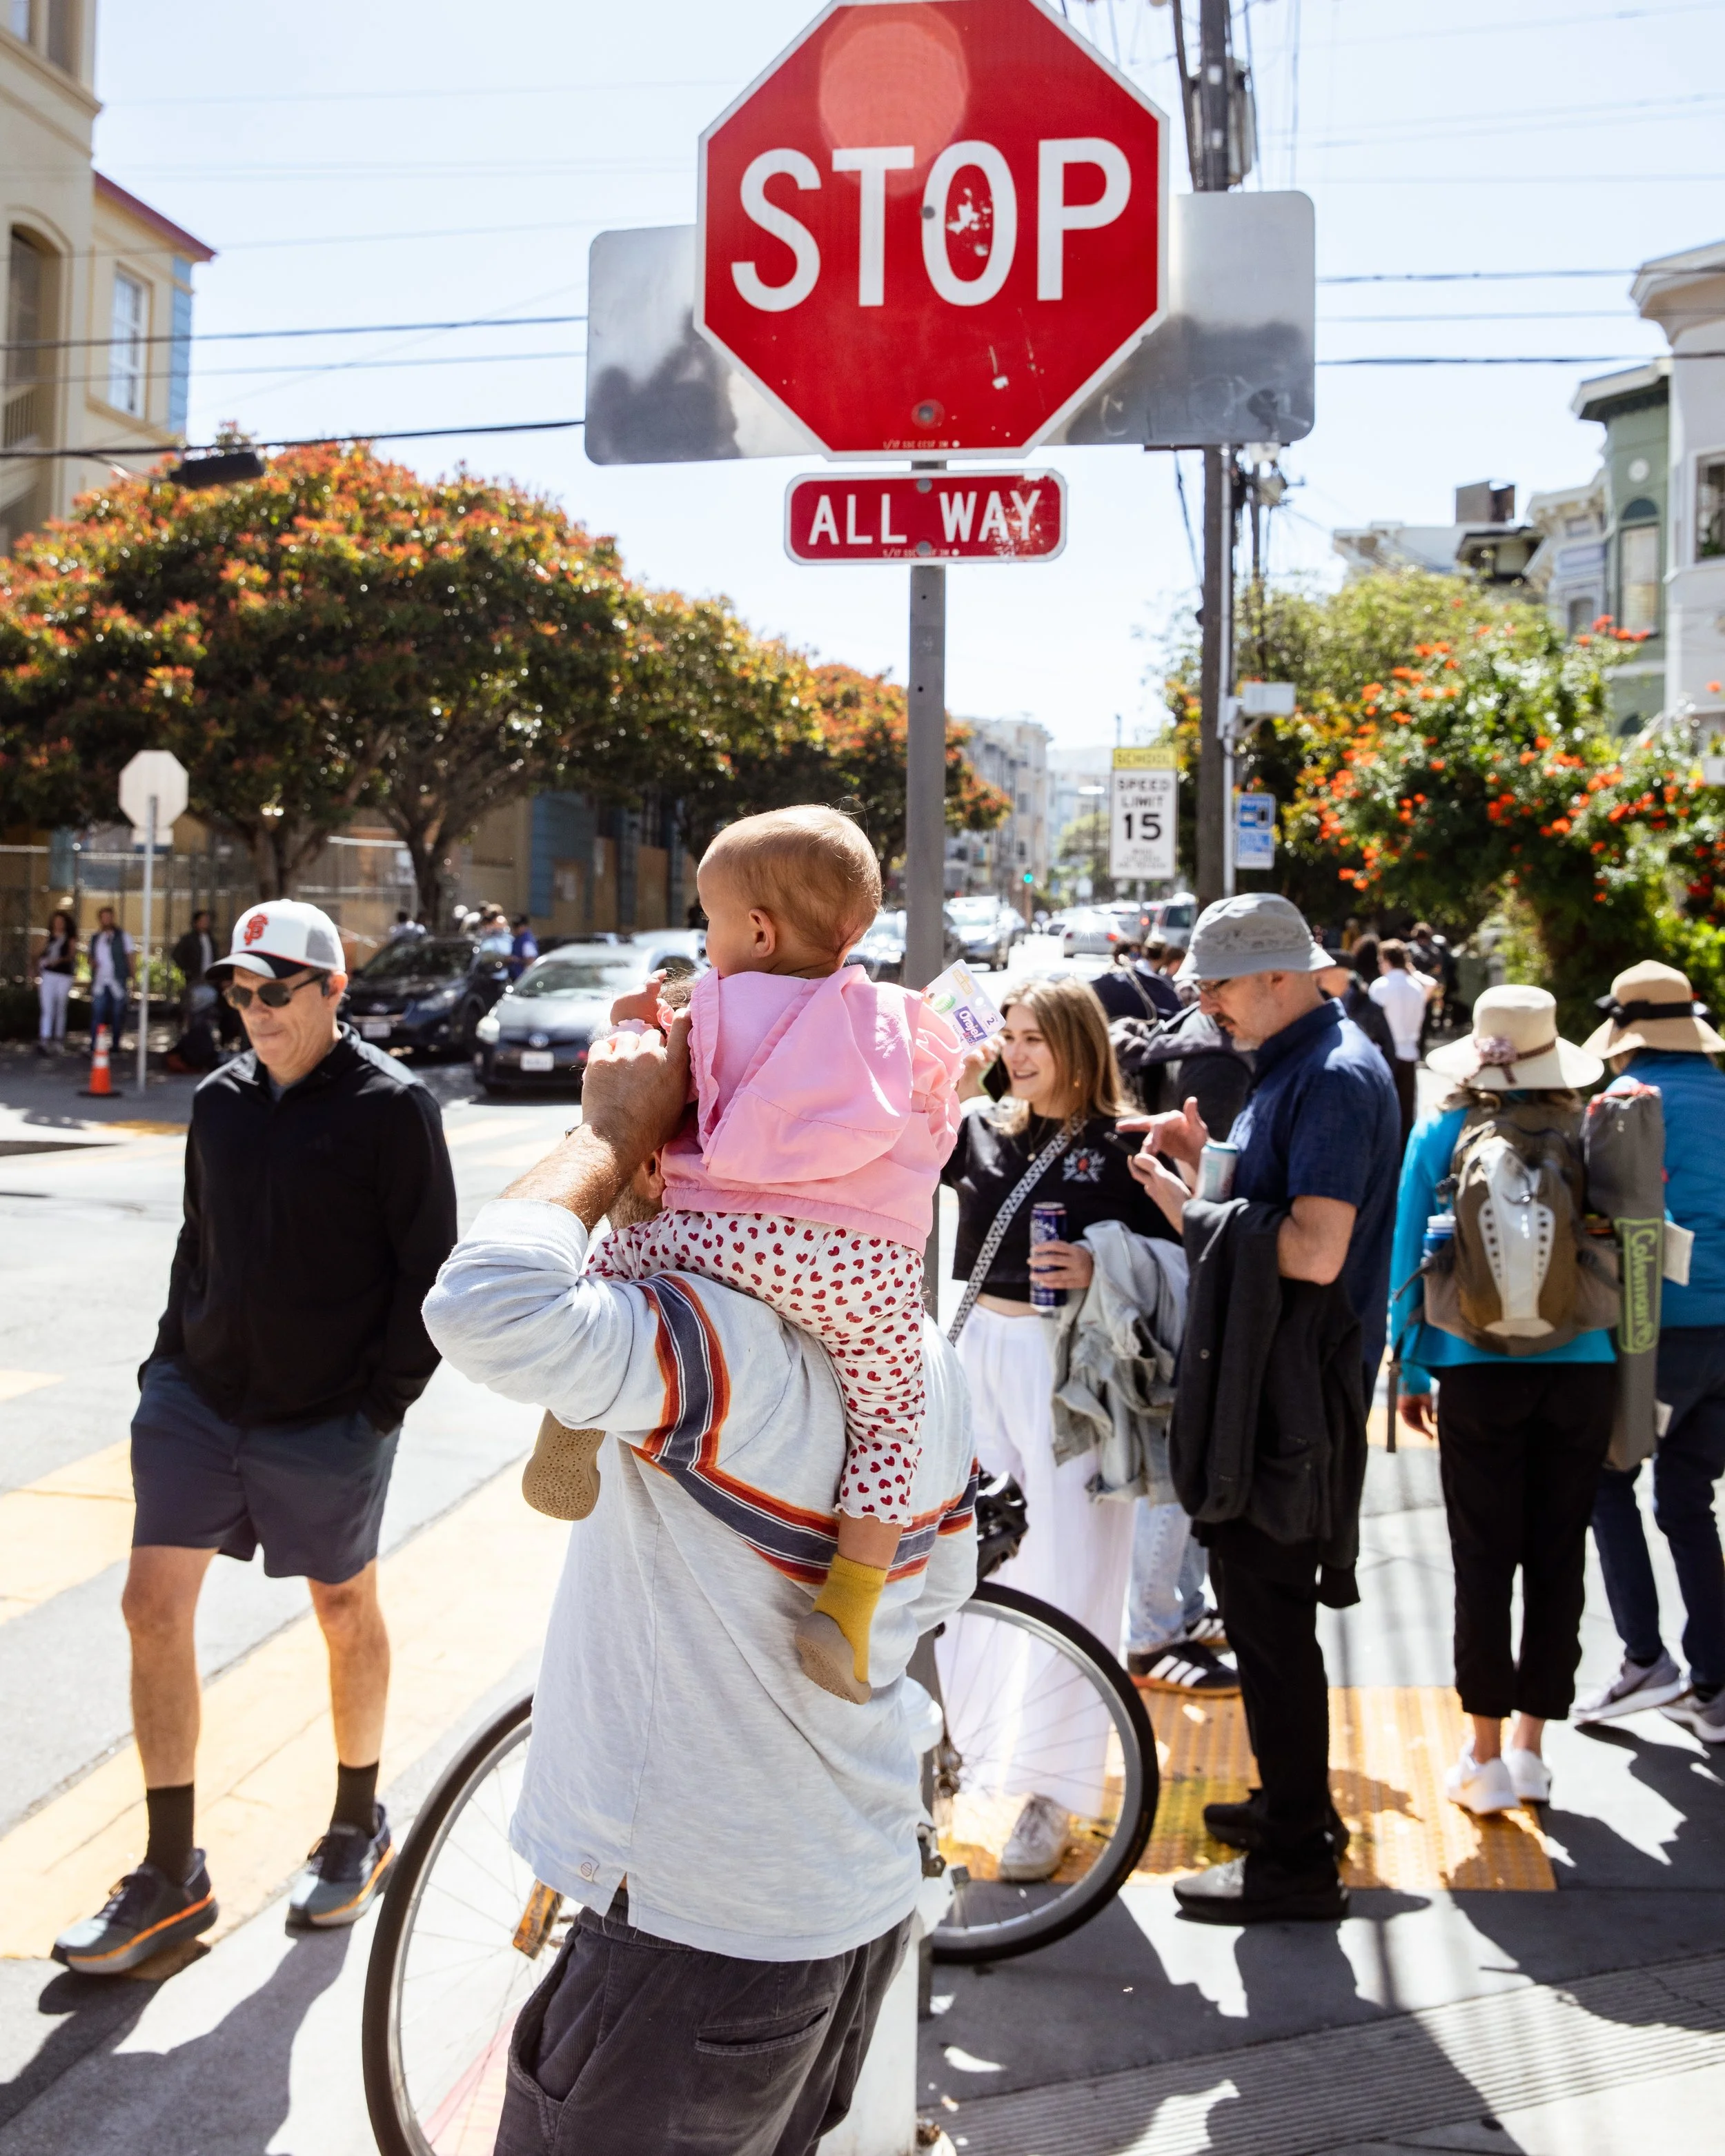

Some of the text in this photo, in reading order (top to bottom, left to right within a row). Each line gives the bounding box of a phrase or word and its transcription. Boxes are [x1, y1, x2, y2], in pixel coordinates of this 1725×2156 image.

[731, 137, 1132, 312] STOP
[808, 489, 1042, 545] ALL WAY
[1116, 753, 1171, 764] SCHOOL
[1117, 778, 1171, 791] SPEED
[1121, 795, 1164, 808] LIMIT
[1124, 812, 1162, 840] 15
[959, 1010, 984, 1040] Orajel
